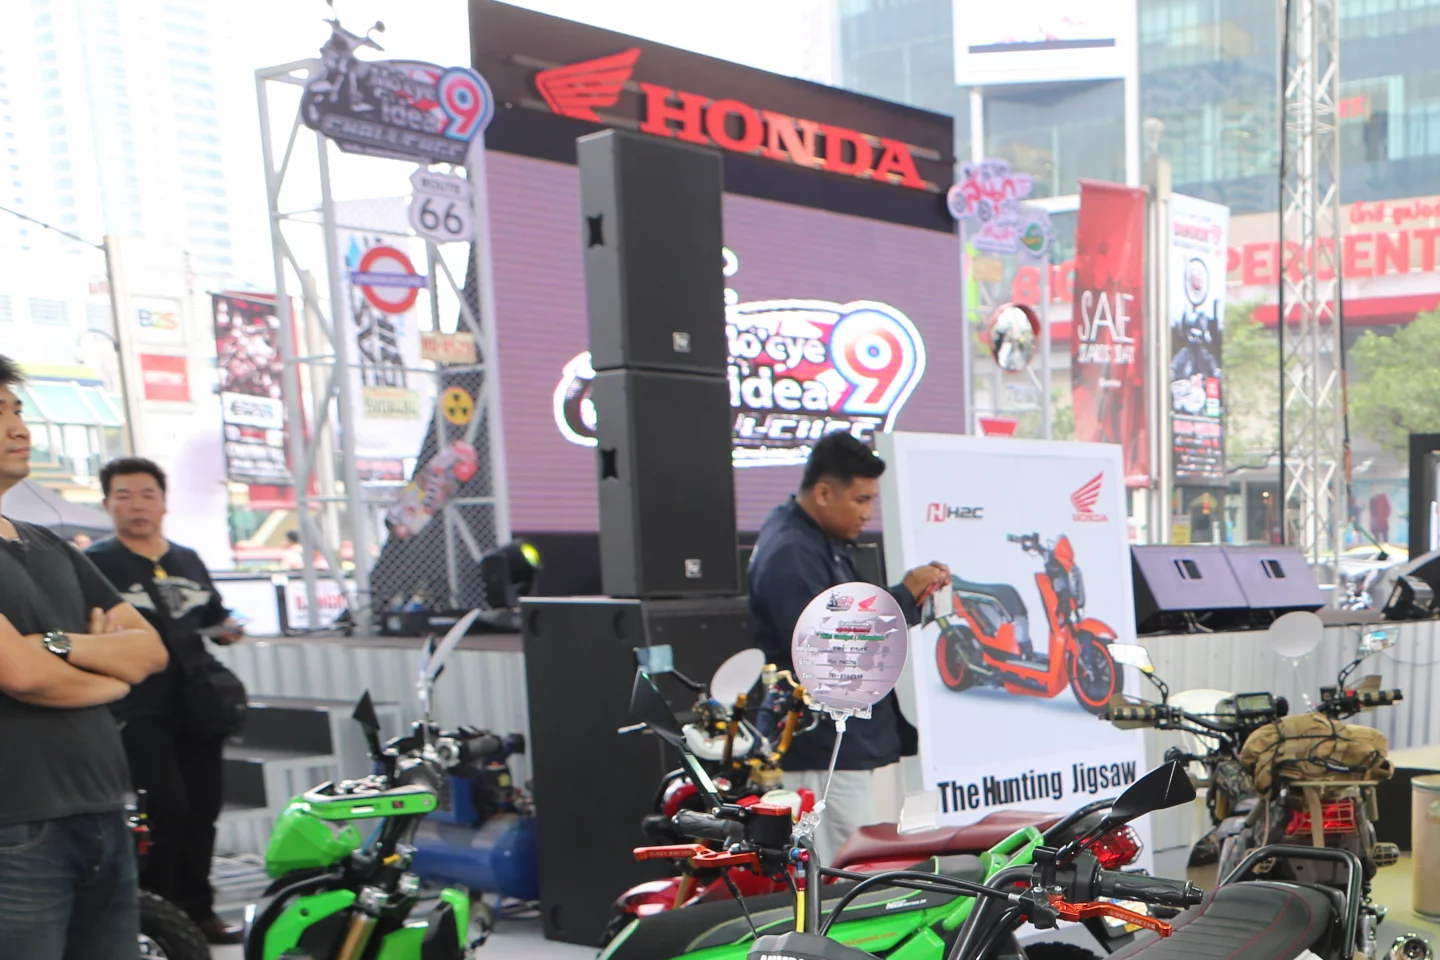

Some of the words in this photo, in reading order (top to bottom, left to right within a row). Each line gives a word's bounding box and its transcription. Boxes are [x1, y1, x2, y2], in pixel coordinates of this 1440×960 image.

[443, 72, 485, 137] 9
[639, 82, 926, 190] HONDA
[419, 197, 463, 235] 66
[830, 308, 918, 415] 9
[728, 365, 829, 411] idea
[947, 506, 984, 520] H2C
[1072, 513, 1109, 523] HONDA
[937, 780, 979, 814] The
[982, 769, 1063, 807] Hunting
[1072, 760, 1137, 795] Jigsaw
